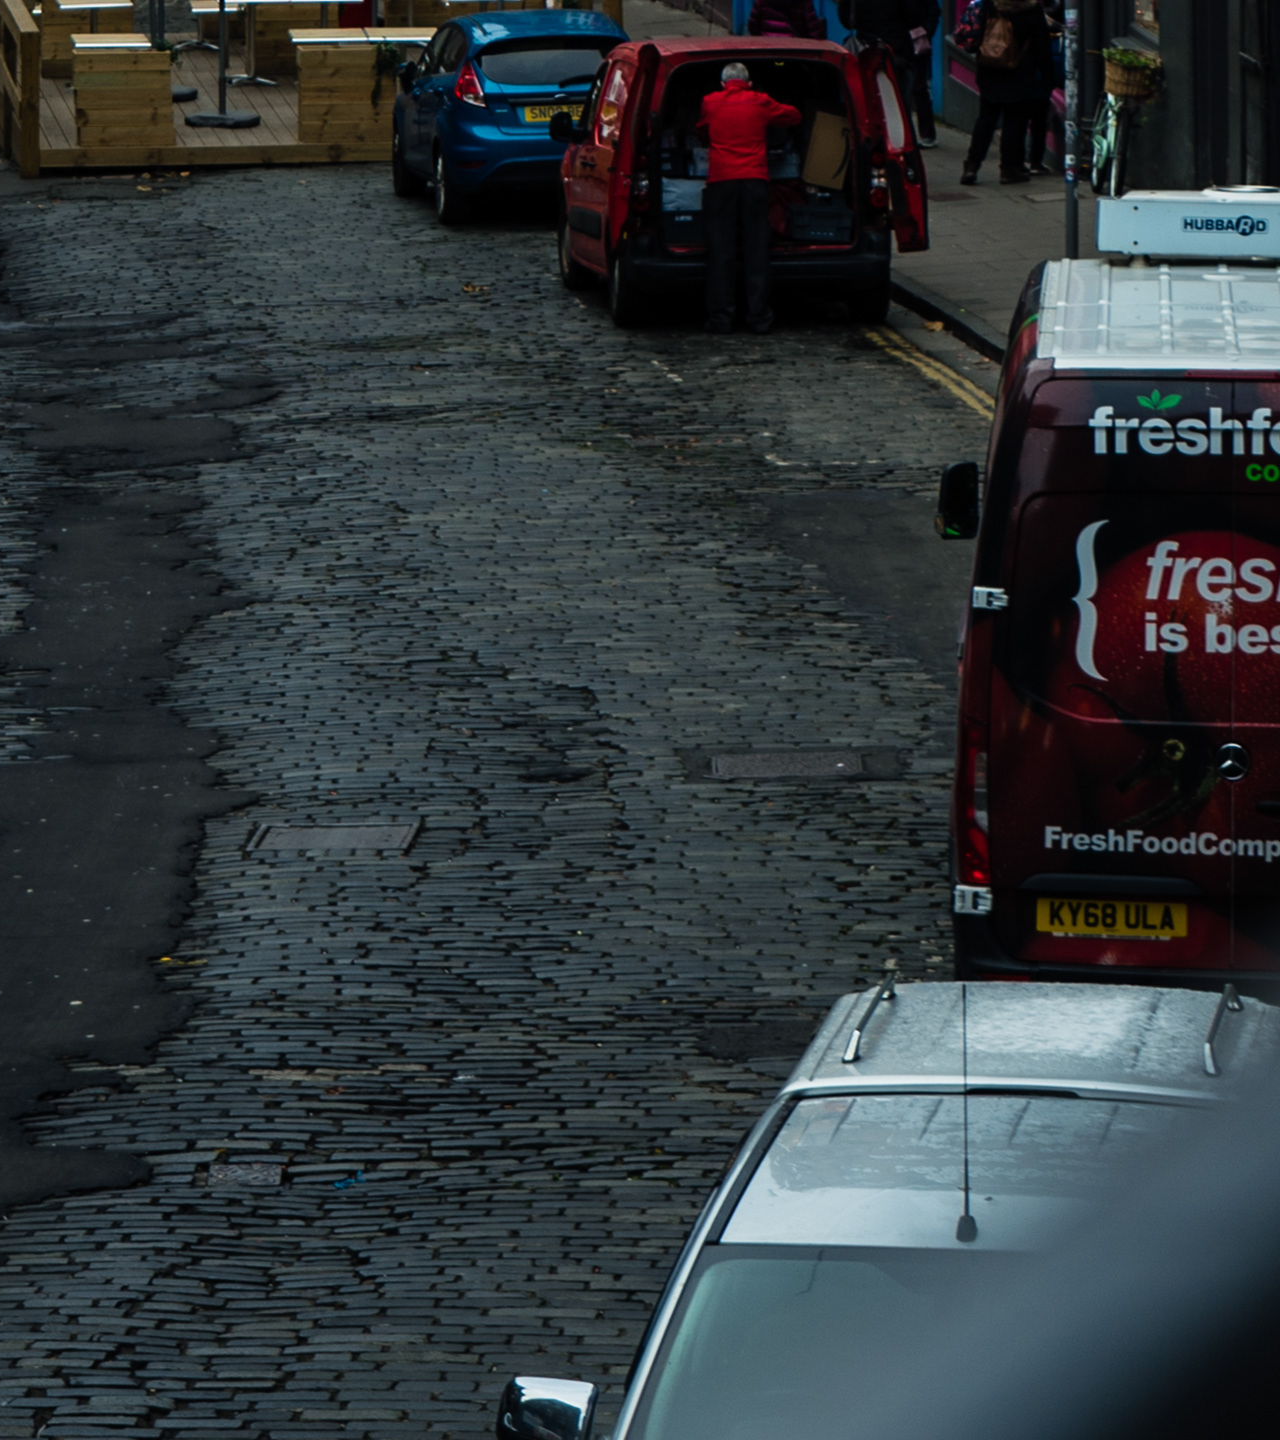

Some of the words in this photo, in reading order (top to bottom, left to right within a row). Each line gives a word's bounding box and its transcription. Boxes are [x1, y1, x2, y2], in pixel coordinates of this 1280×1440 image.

[1184, 216, 1266, 236] HUBBARD
[1144, 612, 1190, 653] is
[1049, 901, 1116, 927] KY68
[1125, 903, 1175, 930] ULA
